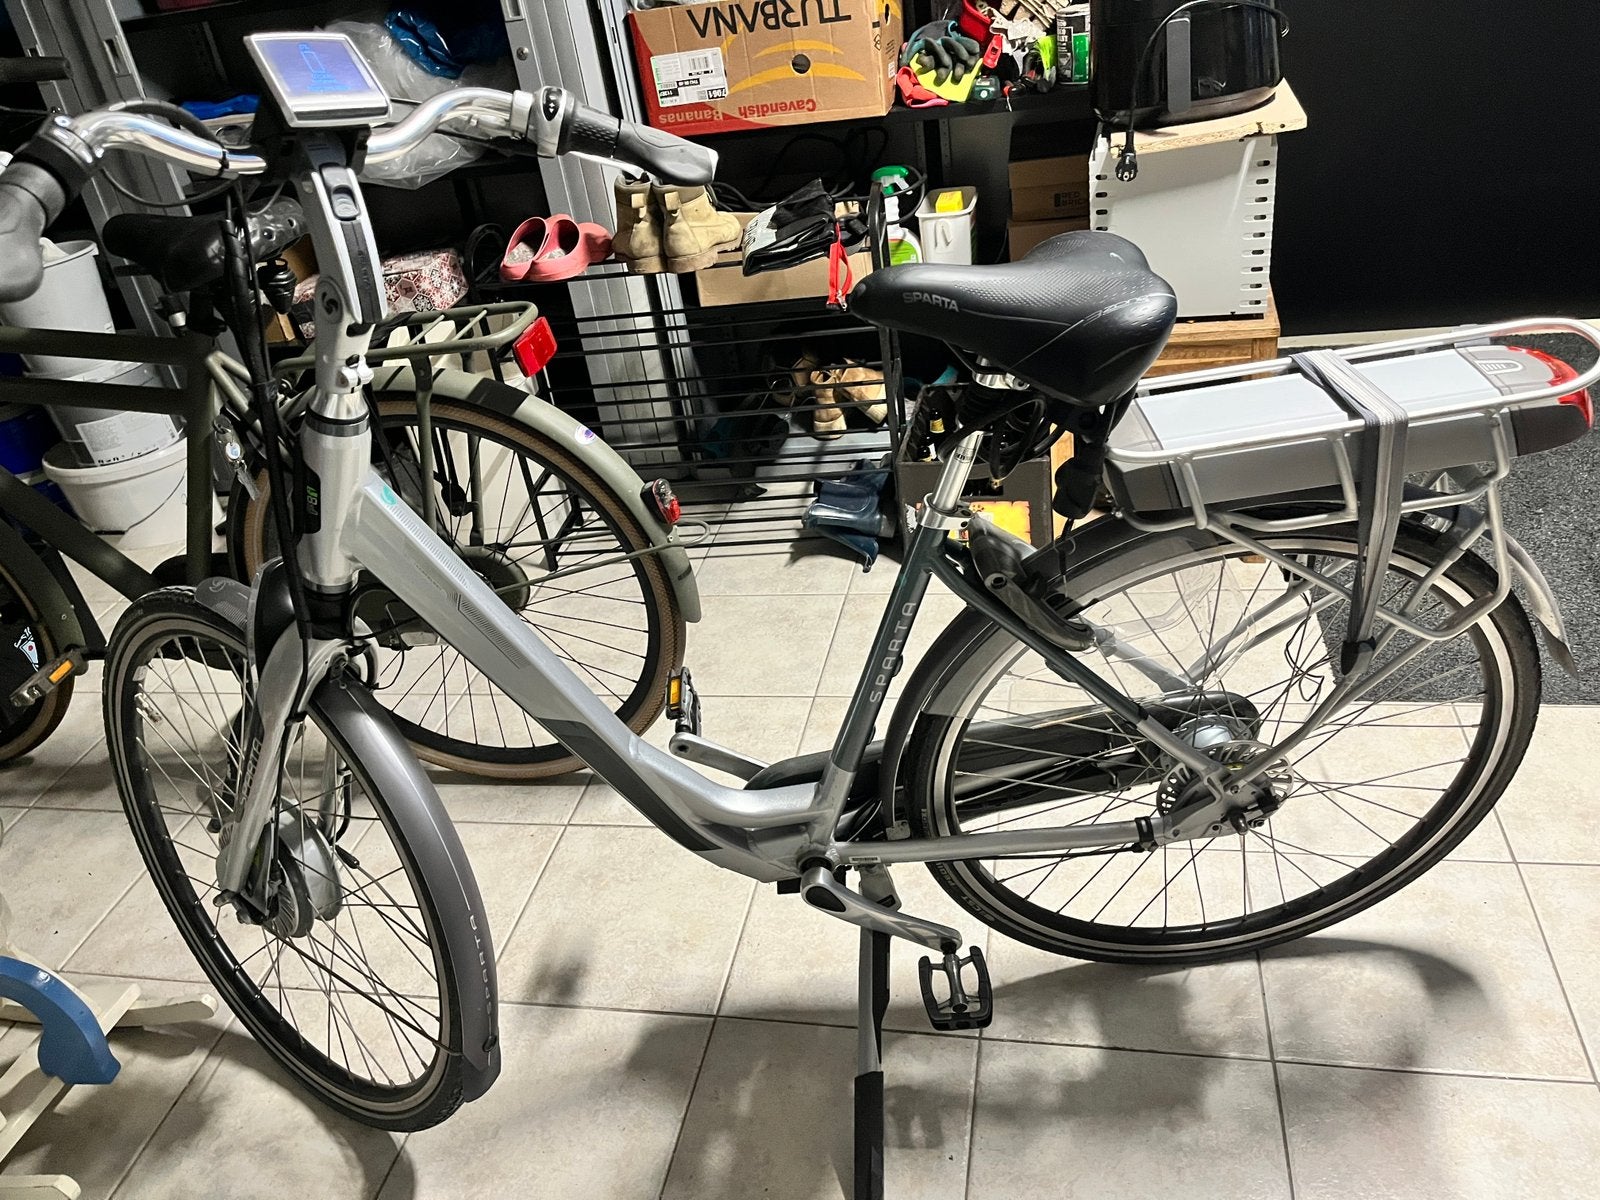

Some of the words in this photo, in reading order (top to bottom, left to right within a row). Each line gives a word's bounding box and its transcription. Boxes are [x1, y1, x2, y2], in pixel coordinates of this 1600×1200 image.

[686, 0, 852, 38] TURBANA
[658, 110, 724, 125] Bananas
[738, 98, 817, 119] Cavendish
[902, 291, 960, 312] SPARTA
[870, 600, 917, 704] SPARTA
[469, 914, 492, 1015] SPARTA
